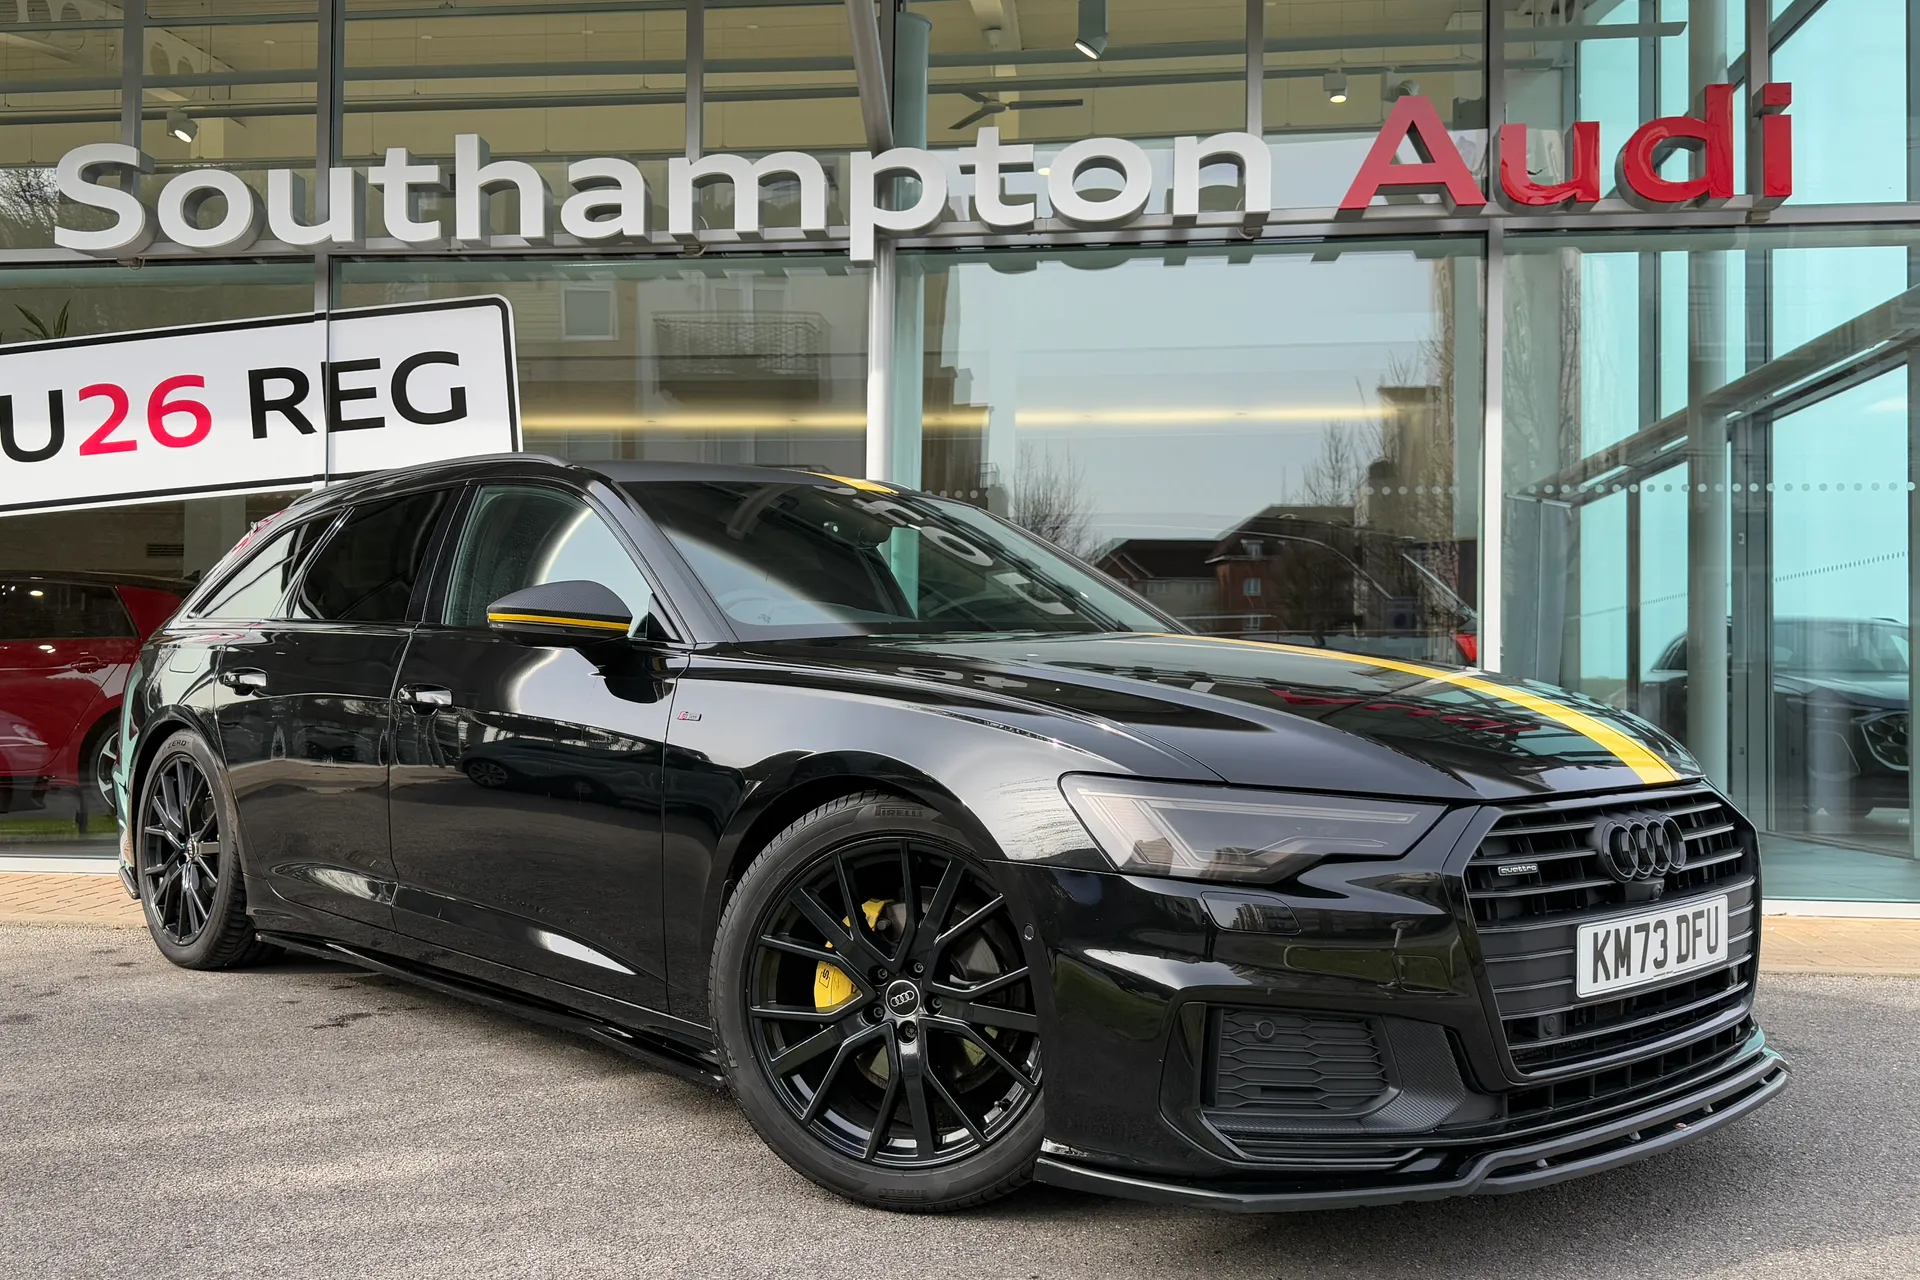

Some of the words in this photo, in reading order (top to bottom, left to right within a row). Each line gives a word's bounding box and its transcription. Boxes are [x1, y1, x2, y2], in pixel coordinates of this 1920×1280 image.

[54, 126, 1271, 265] Southampton
[1336, 83, 1792, 213] Audi
[0, 374, 212, 463] U26
[247, 350, 468, 439] REG
[1500, 865, 1537, 875] quattro
[1592, 919, 1669, 984] KM73
[1676, 905, 1719, 964] DFU
